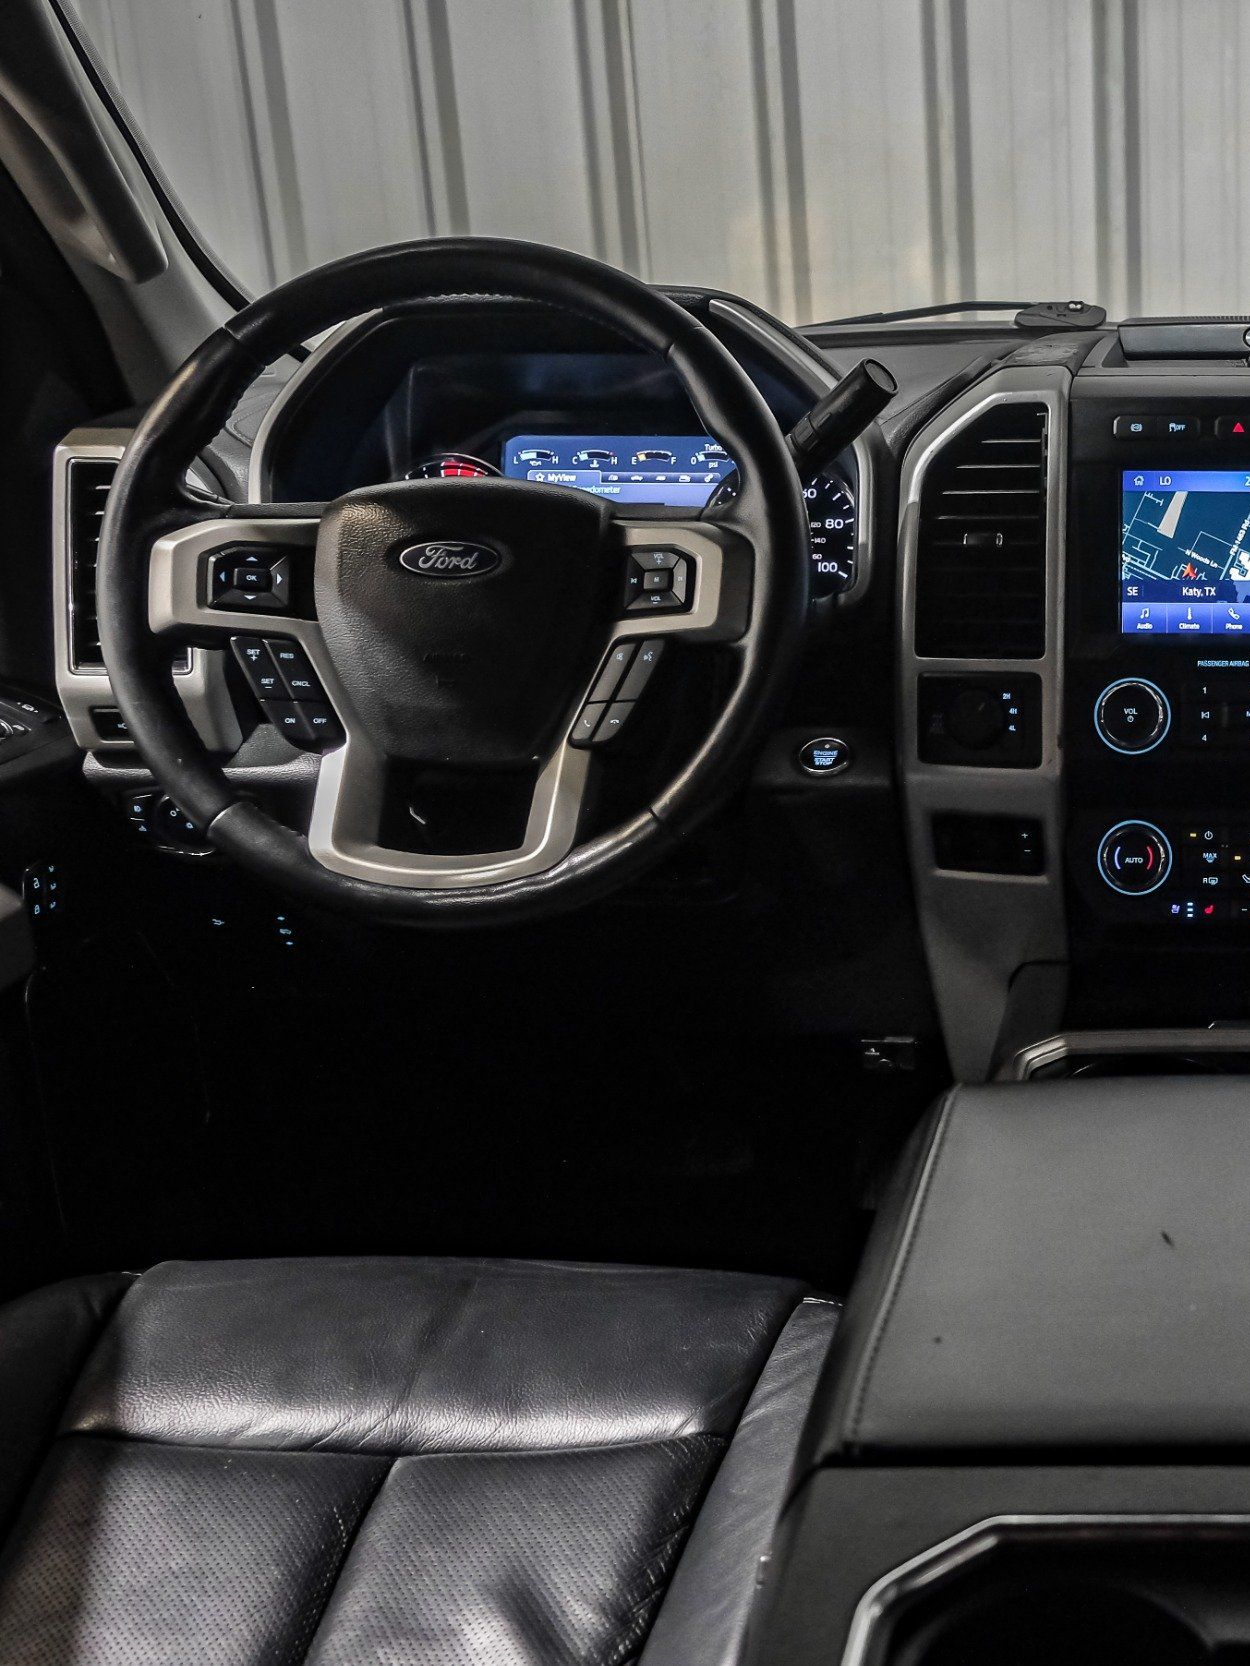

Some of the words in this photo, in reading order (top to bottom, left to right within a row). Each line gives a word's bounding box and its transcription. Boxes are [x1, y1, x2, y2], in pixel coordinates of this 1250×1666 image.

[704, 443, 723, 451] Turbo
[551, 456, 559, 464] H
[572, 456, 578, 464] C
[610, 456, 618, 465] H
[631, 457, 637, 465] E
[671, 456, 677, 464] F
[708, 461, 718, 469] psi
[547, 473, 576, 483] MyView
[1159, 476, 1172, 486] LO
[825, 519, 844, 529] 80
[418, 543, 479, 570] Ford
[817, 562, 838, 573] 100
[1126, 586, 1139, 596] SE
[1182, 586, 1202, 597] Katy,
[1204, 586, 1216, 596] TX
